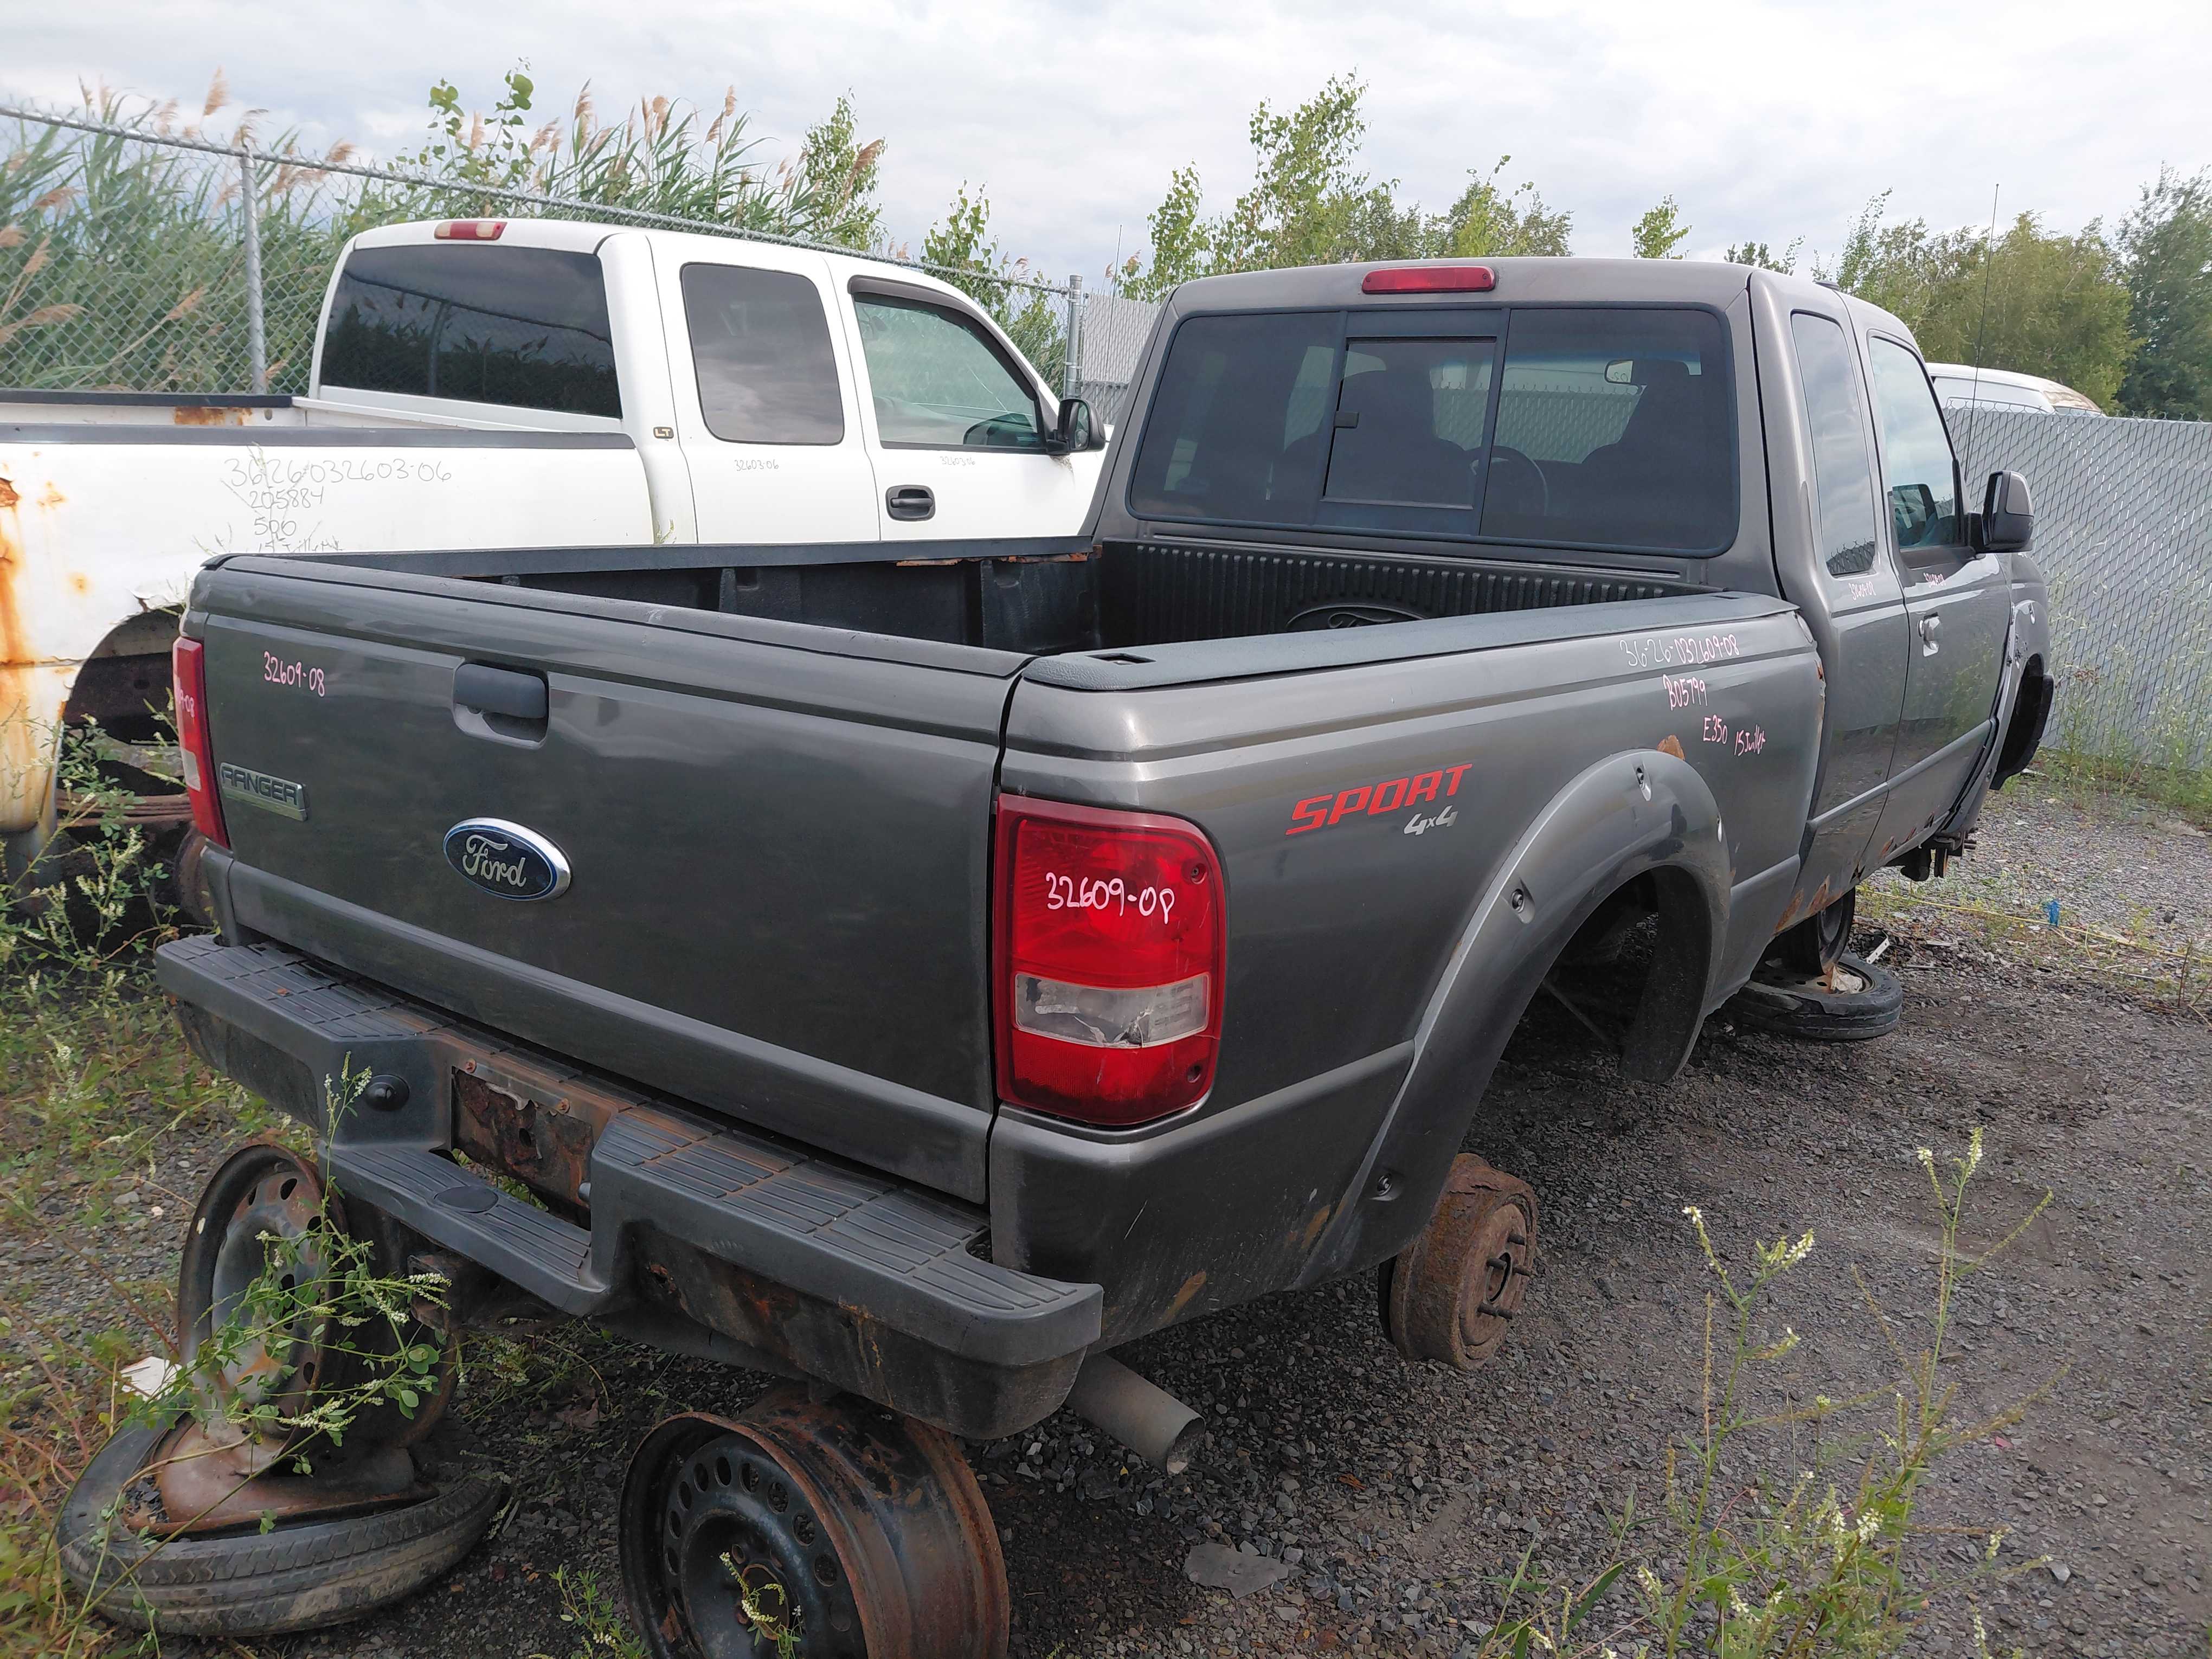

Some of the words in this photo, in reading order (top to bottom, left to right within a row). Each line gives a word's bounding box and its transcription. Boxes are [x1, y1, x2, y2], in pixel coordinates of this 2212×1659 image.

[654, 428, 671, 437] LT
[264, 651, 325, 698] 32609-08
[1703, 714, 1728, 744] E350
[221, 765, 298, 806] RANGER
[1284, 763, 1473, 835] SPORT
[1403, 805, 1458, 835] 4x4
[462, 834, 528, 888] Ford
